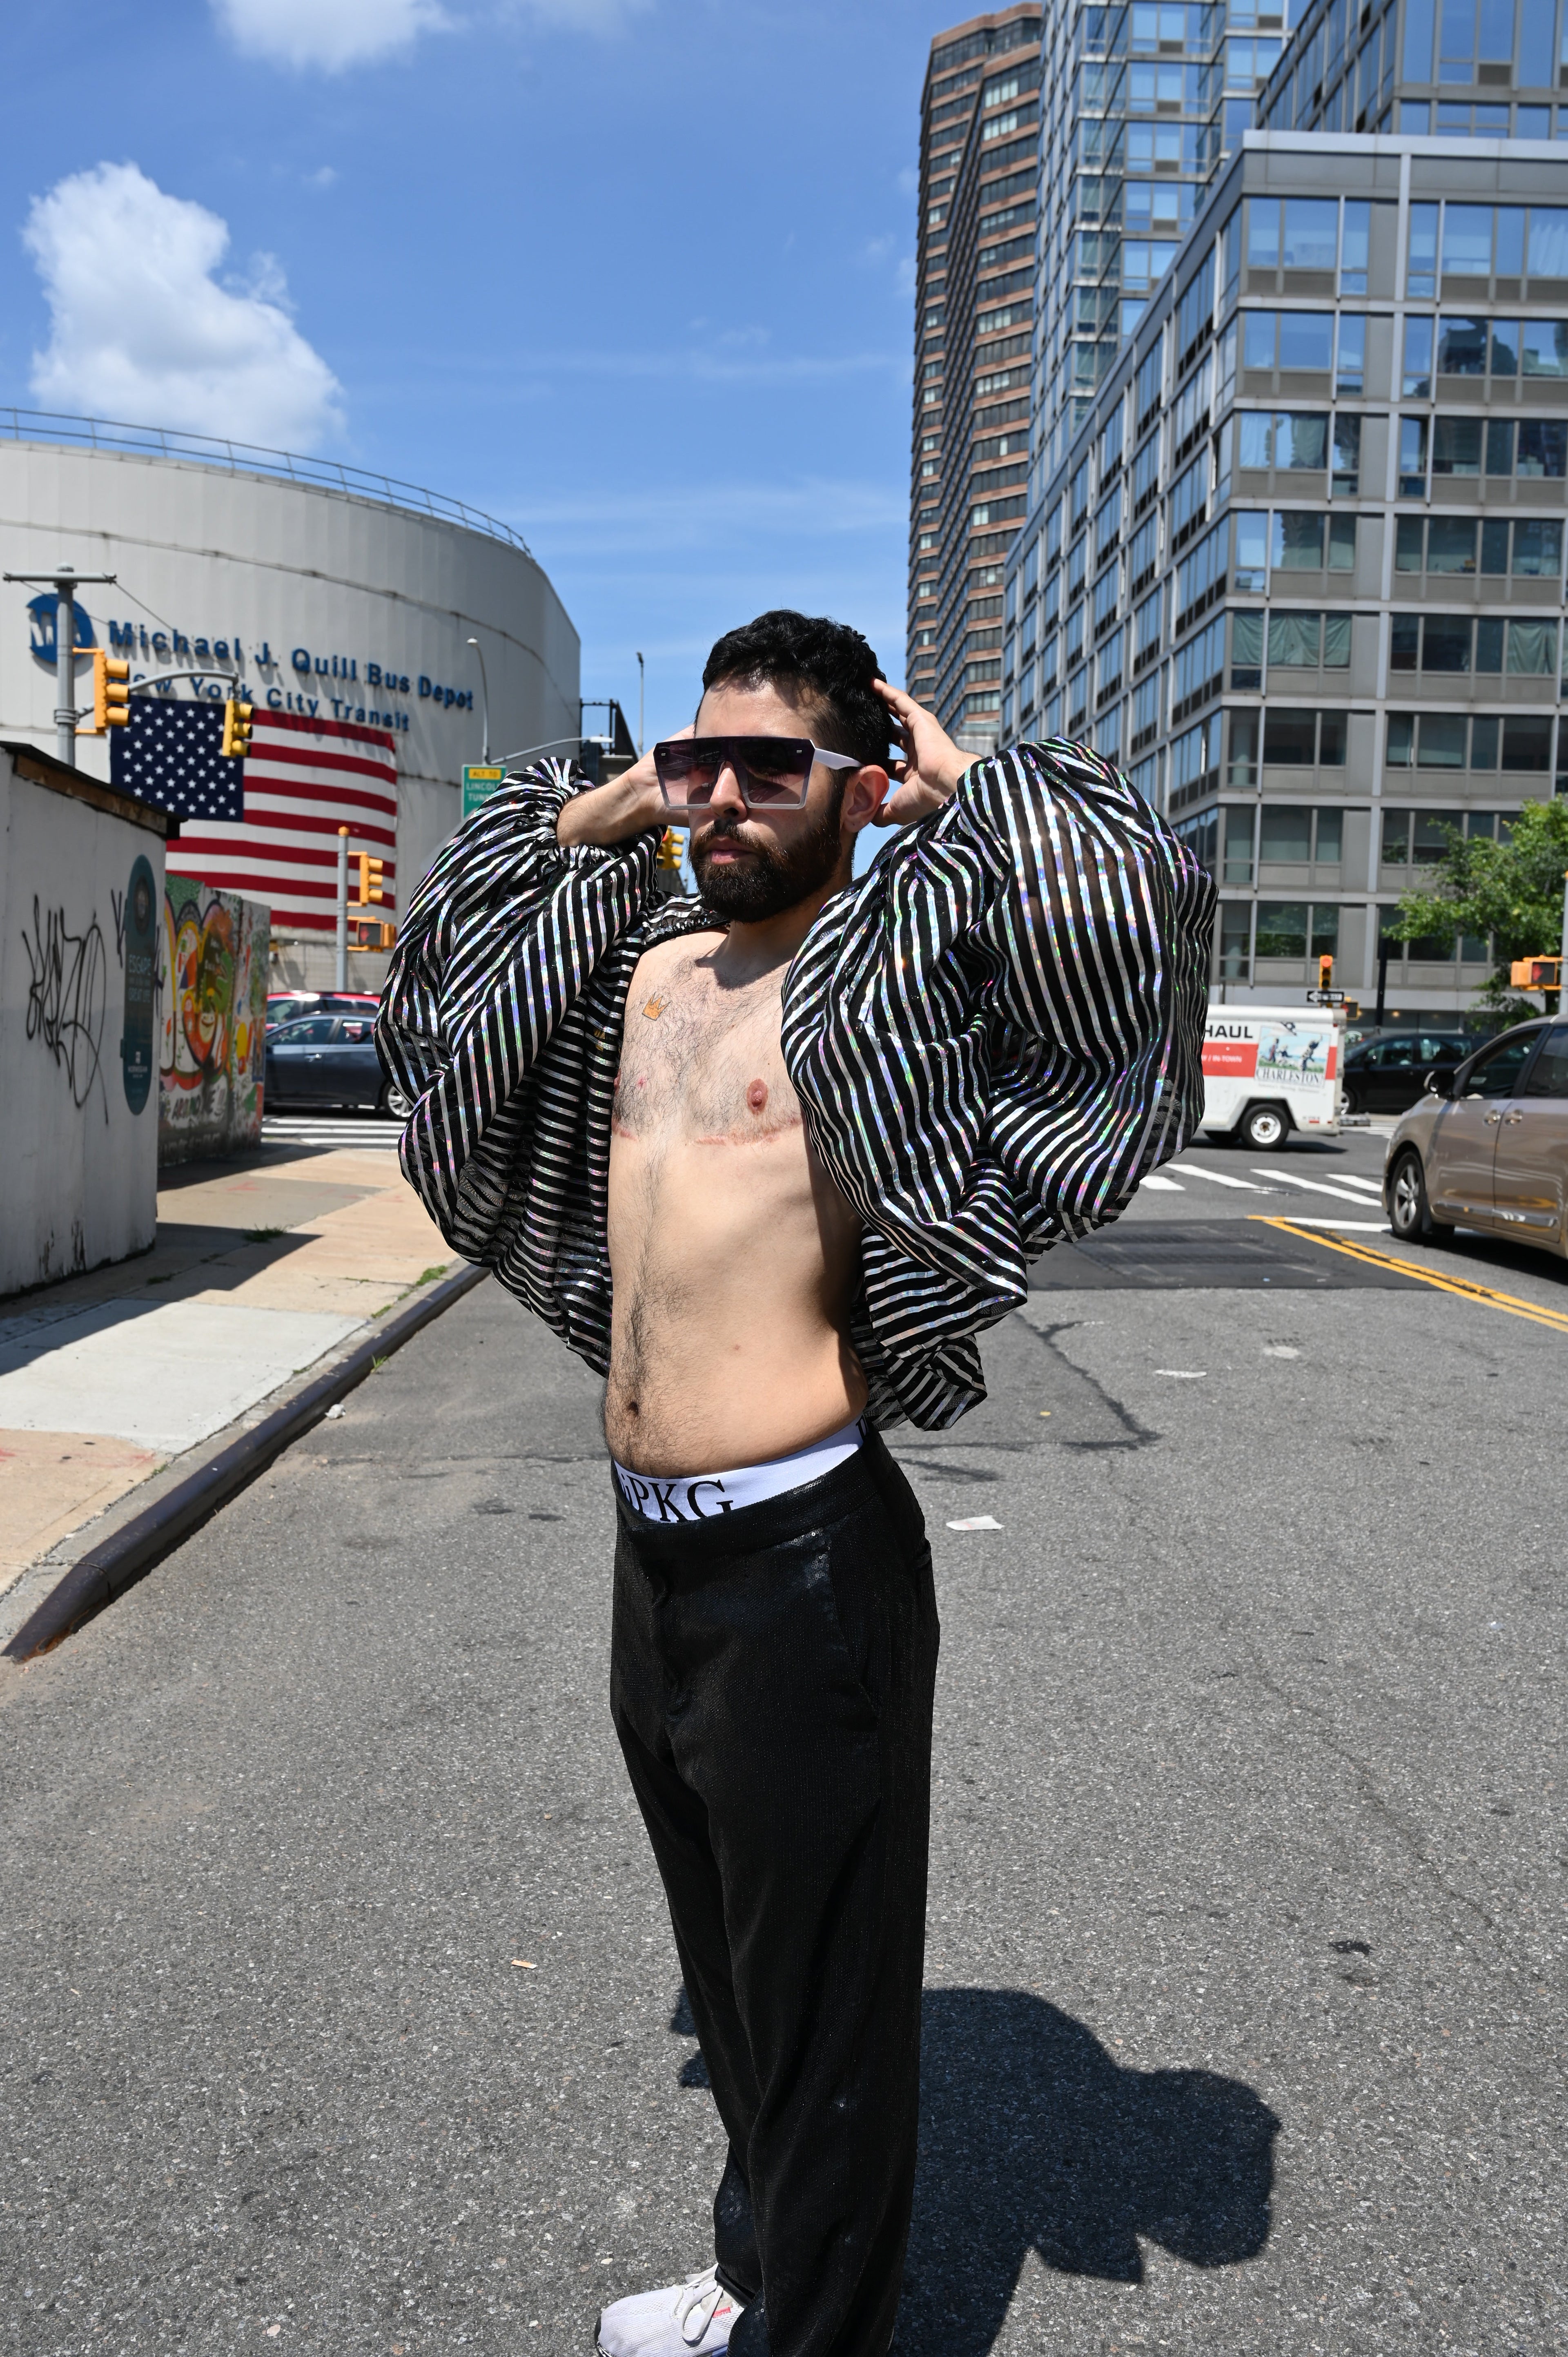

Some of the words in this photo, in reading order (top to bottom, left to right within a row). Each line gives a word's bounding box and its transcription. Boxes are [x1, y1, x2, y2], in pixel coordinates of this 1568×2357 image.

[109, 620, 240, 661] Michael
[255, 642, 278, 667] J.
[292, 648, 356, 681] Quill
[368, 662, 410, 693] Bus
[419, 675, 473, 711] Depot
[267, 688, 319, 718] City
[331, 698, 409, 732] Transit
